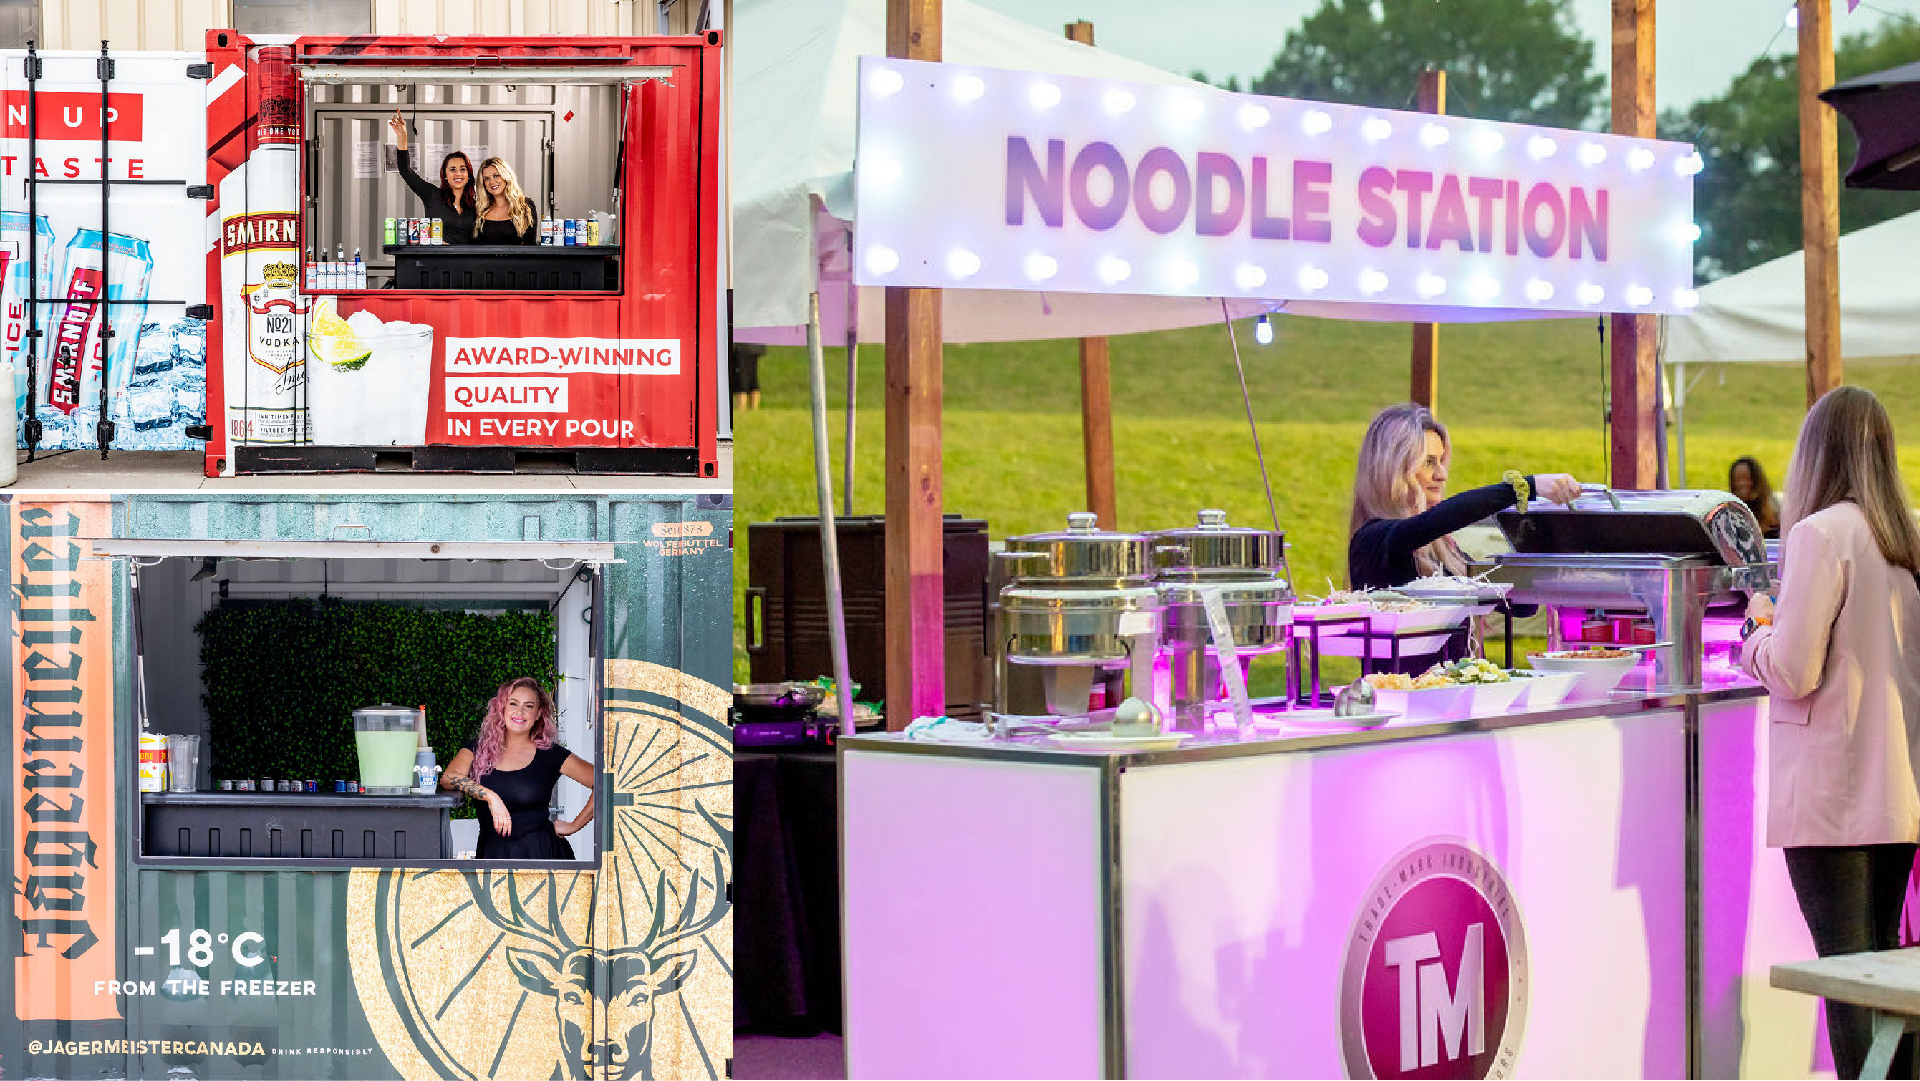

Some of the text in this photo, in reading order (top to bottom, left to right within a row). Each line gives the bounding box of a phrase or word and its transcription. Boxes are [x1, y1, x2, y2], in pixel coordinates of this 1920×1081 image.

[63, 106, 119, 128] UP
[0, 155, 144, 179] TASTE
[1004, 135, 1609, 263] NOODLE STATION
[259, 335, 300, 348] VODKA
[453, 346, 672, 368] AWARD-WINNING
[454, 386, 560, 408] QUALITY
[231, 419, 254, 438] 1864
[447, 418, 634, 438] IN EVERY POUR
[134, 928, 265, 967] -18°C
[93, 979, 317, 997] FROM THE FREEZER
[1383, 922, 1485, 1073] TM
[28, 1038, 373, 1057] @JAGERMEISTERCANADA DRINK RESPONSIBLY
